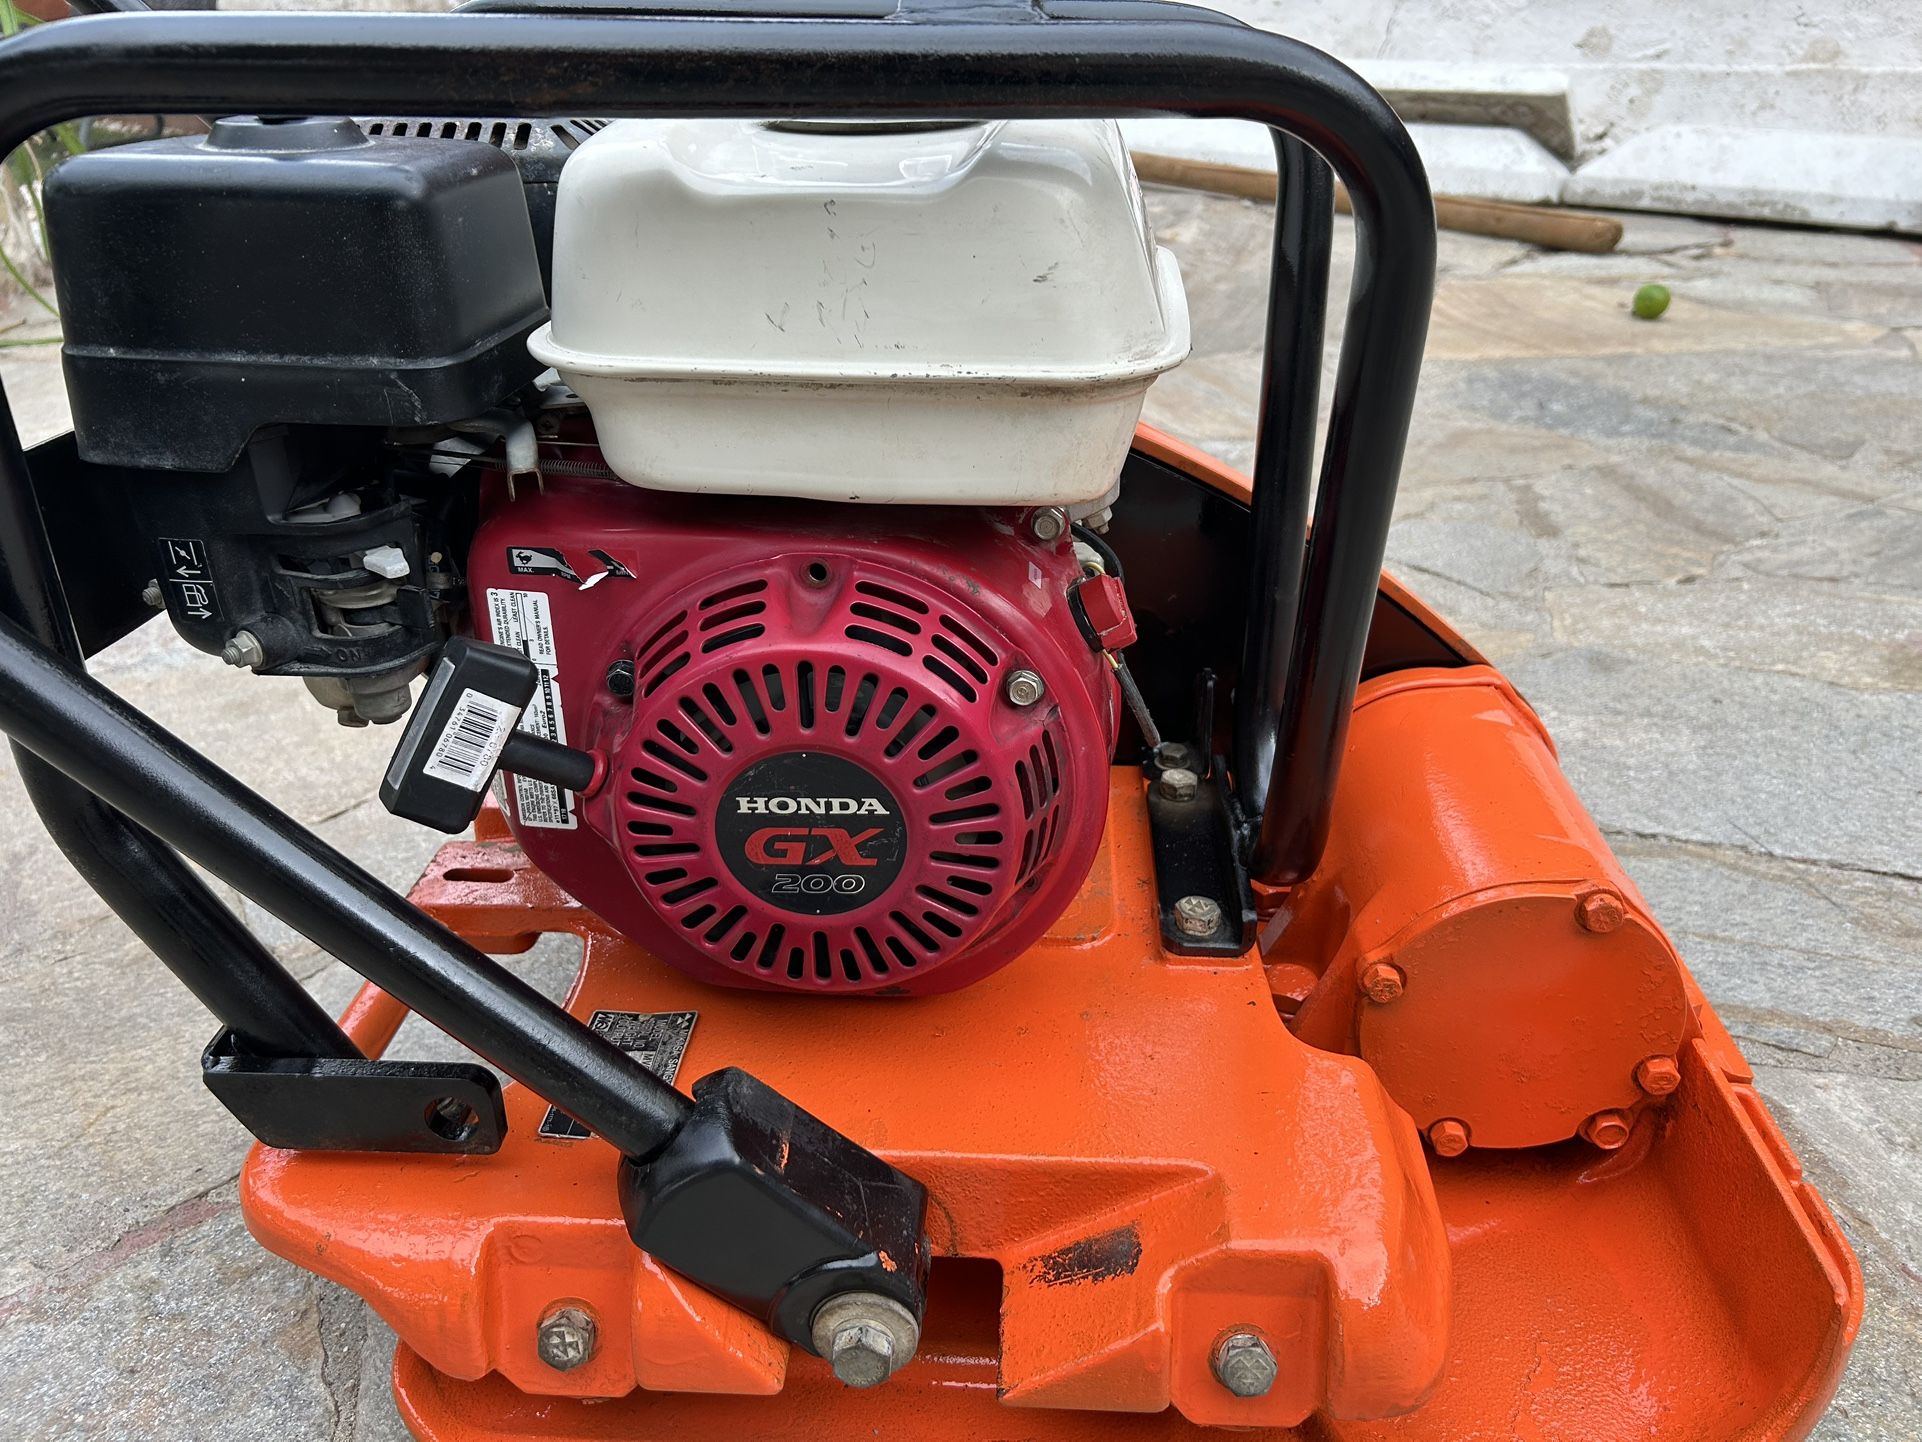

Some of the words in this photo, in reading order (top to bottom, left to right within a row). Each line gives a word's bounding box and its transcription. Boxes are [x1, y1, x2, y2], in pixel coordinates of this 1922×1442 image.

[517, 566, 534, 574] MAX.
[498, 626, 506, 646] NGINE'S
[504, 625, 512, 647] XTENDED
[335, 646, 362, 662] ON
[539, 710, 547, 729] Euro2
[735, 796, 890, 815] HONDA
[744, 827, 885, 866] GX
[771, 874, 866, 894] 200
[663, 1059, 678, 1085] SANGY
